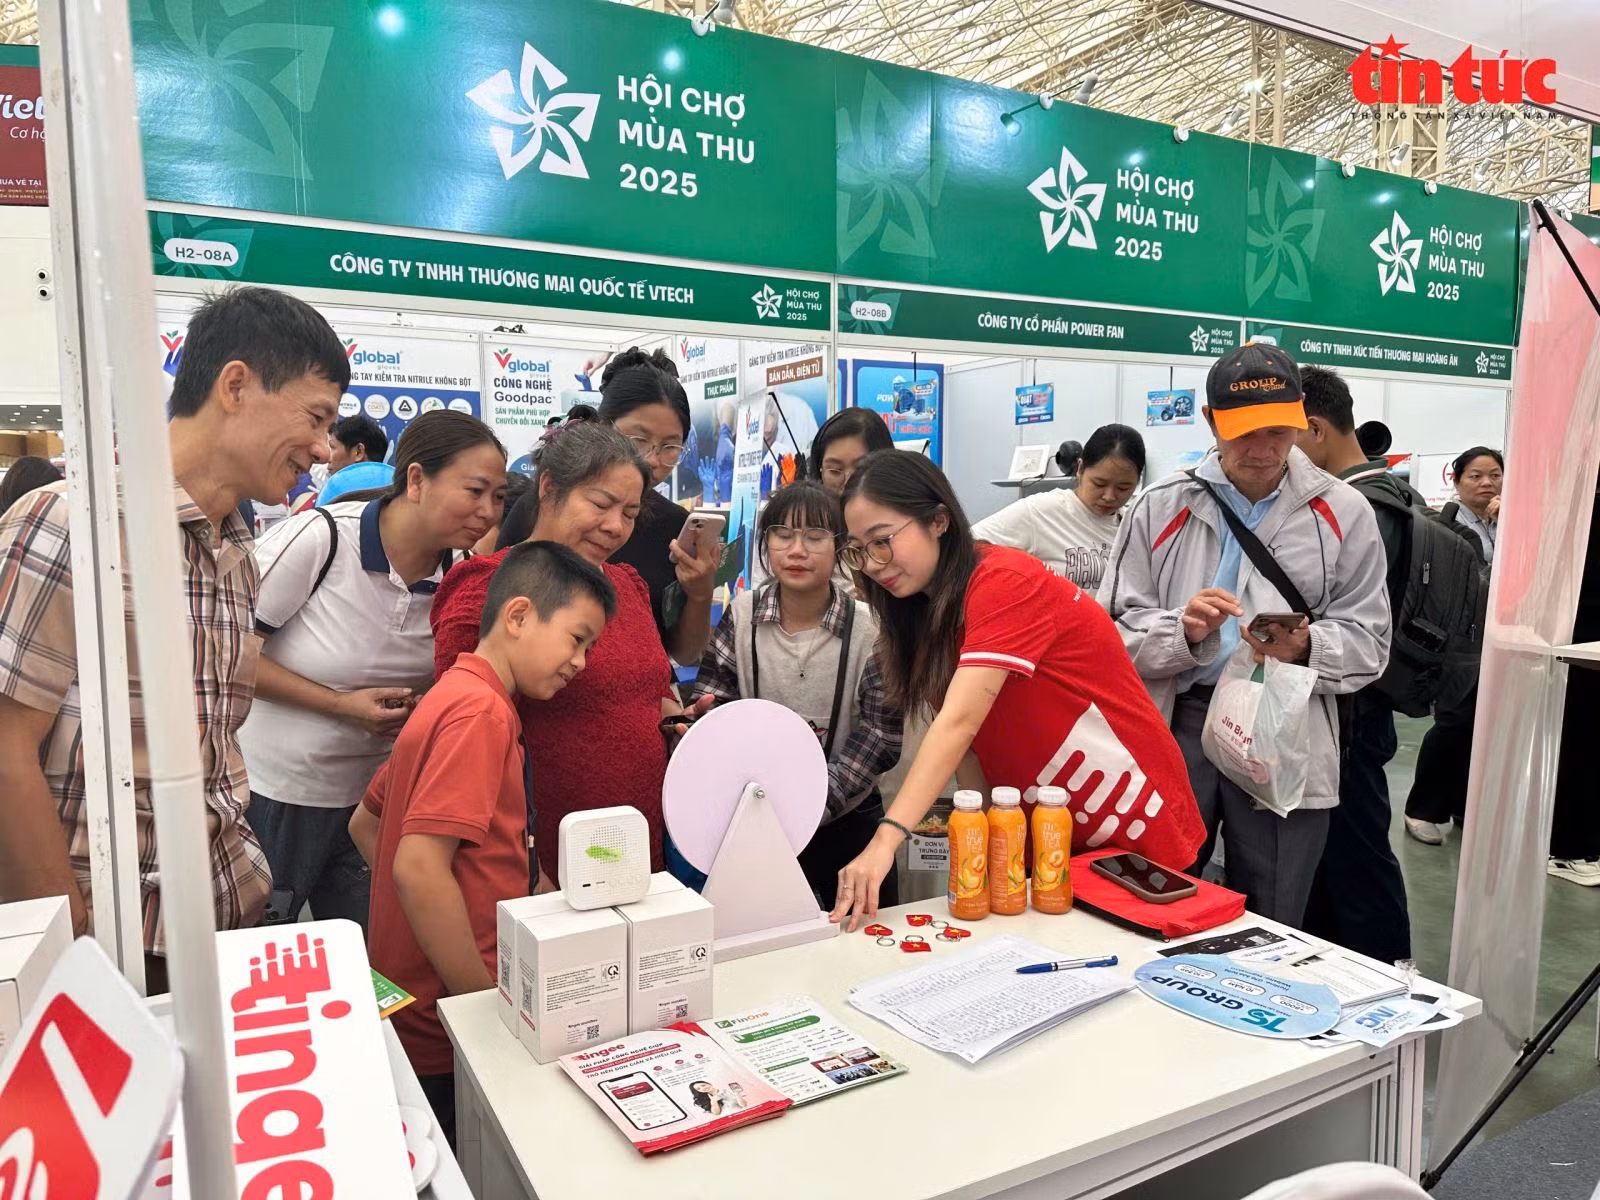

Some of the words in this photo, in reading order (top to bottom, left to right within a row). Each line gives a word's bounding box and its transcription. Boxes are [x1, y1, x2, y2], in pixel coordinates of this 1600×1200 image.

[617, 73, 672, 114] HỘI
[681, 86, 746, 127] CHỢ
[618, 117, 688, 154] MÙA
[697, 132, 755, 164] THU
[619, 163, 698, 198] 2025
[1116, 166, 1150, 197] HỘI
[1154, 176, 1195, 206] CHỢ
[1116, 200, 1157, 229] MÙA
[1163, 210, 1199, 234] THU
[1115, 236, 1163, 261] 2025
[1429, 224, 1452, 247] HỘI
[1455, 231, 1483, 253] CHỢ
[175, 247, 233, 262] H2-08A
[1428, 252, 1457, 274] MÙA
[1461, 259, 1485, 278] THU
[330, 251, 384, 275] CÔNG
[388, 259, 412, 278] TY
[415, 262, 464, 283] TNHH
[468, 266, 539, 289] THƯƠNG
[544, 273, 575, 294] MẠI
[579, 276, 625, 298] QUỐC
[628, 279, 648, 299] TẾ
[648, 284, 695, 304] VTECH
[786, 288, 801, 299] HỘI
[802, 290, 820, 301] CHỢ
[1427, 282, 1460, 301] 2025
[786, 299, 805, 309] MÙA
[806, 302, 822, 311] THU
[855, 307, 887, 318] H2-08B
[786, 312, 807, 321] 2025
[977, 311, 1008, 329] CÔNG
[1009, 316, 1023, 330] TY
[1024, 313, 1040, 331] CỔ
[1041, 316, 1068, 334] PHẦN
[1070, 322, 1105, 338] POWER
[1106, 325, 1124, 339] FAN
[1300, 339, 1322, 353] CÔNG
[1322, 342, 1332, 354] TY
[1333, 343, 1352, 356] TNHH
[1353, 344, 1368, 357] XÚC
[1412, 351, 1425, 364] MẠI
[361, 373, 373, 381] TAY
[393, 374, 406, 383] TRA
[408, 375, 433, 384] NITRILE
[435, 376, 458, 386] KHÔNG
[460, 378, 472, 388] BỘT
[494, 375, 522, 388] CÔNG
[525, 379, 553, 393] NGHỆ
[1230, 377, 1277, 391] GROUP
[494, 391, 552, 405] Goodpac
[876, 393, 894, 402] POW
[1221, 716, 1234, 730] Jin
[1151, 975, 1244, 1010] GROUP
[731, 1011, 769, 1026] FinOne
[1240, 1008, 1288, 1033] TS
